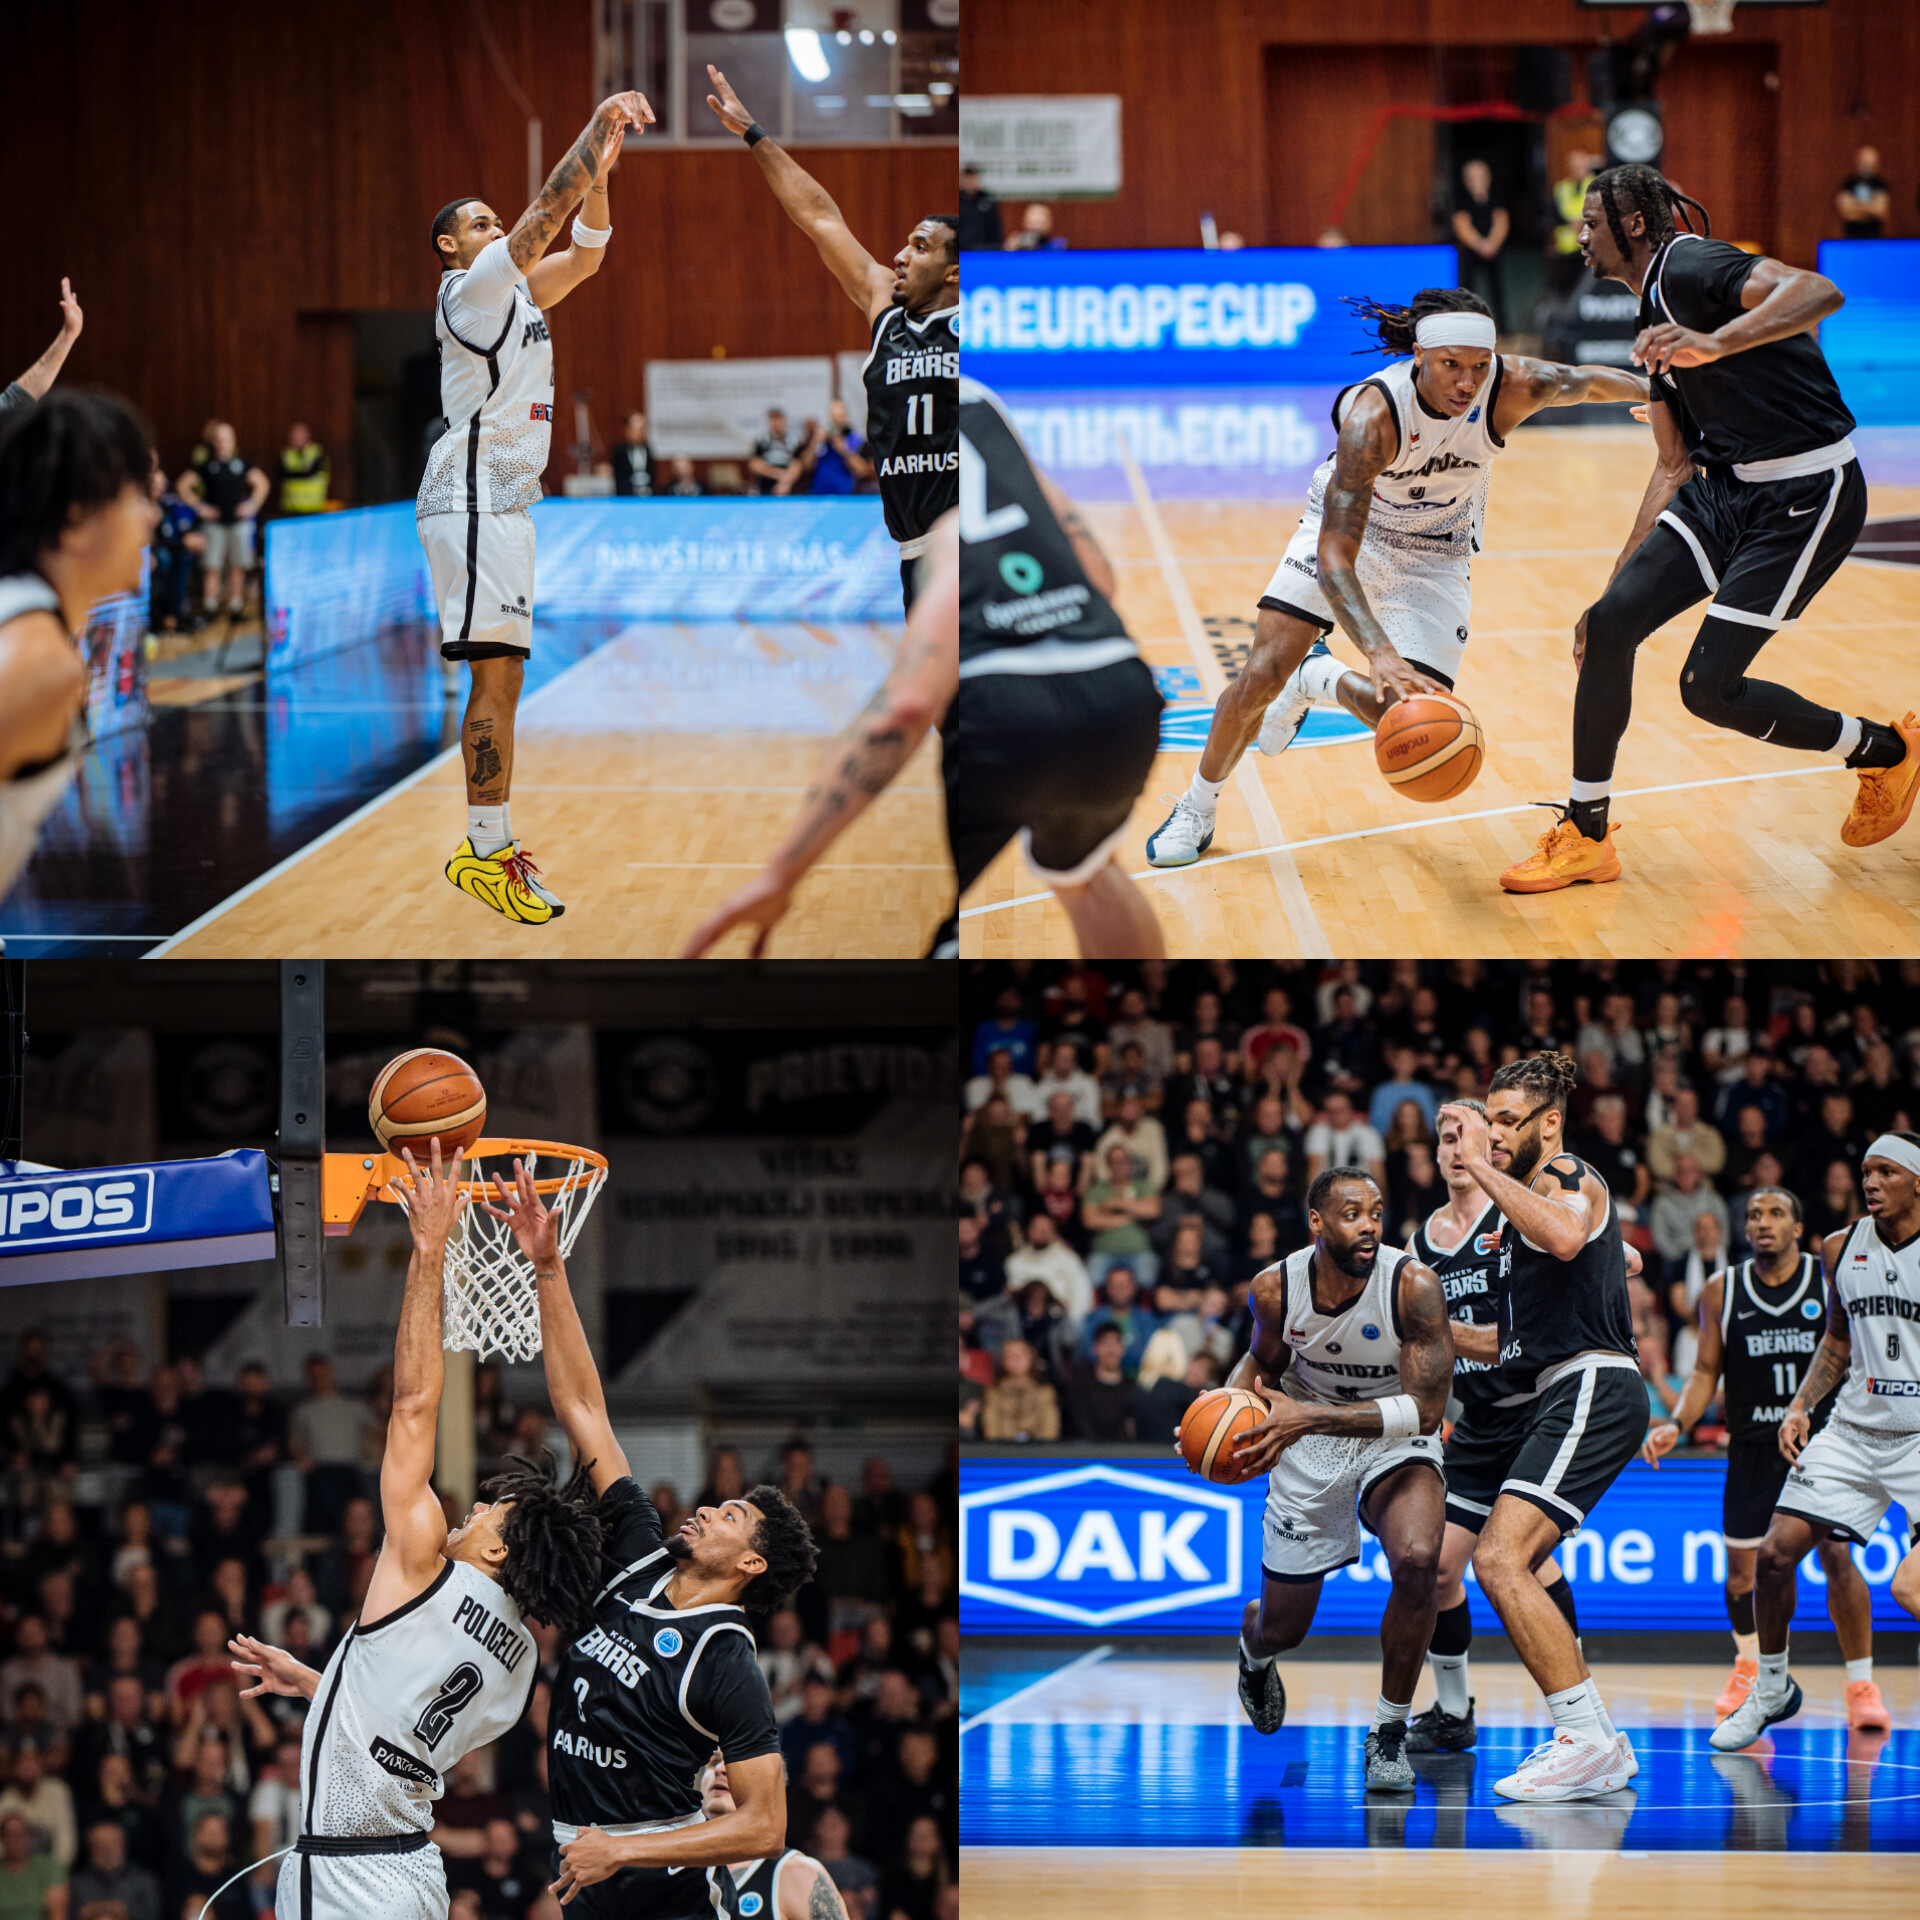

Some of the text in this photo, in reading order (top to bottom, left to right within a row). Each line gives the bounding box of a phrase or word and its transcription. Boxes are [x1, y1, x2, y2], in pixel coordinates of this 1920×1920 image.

[886, 352, 959, 385] BEARS
[907, 393, 933, 435] 11
[880, 452, 959, 477] AARHUS
[1442, 1269, 1489, 1301] EARS
[1745, 1330, 1816, 1357] BEARS
[1772, 1362, 1797, 1396] 11
[988, 1510, 1211, 1582] DAK
[412, 1661, 484, 1754] 2
